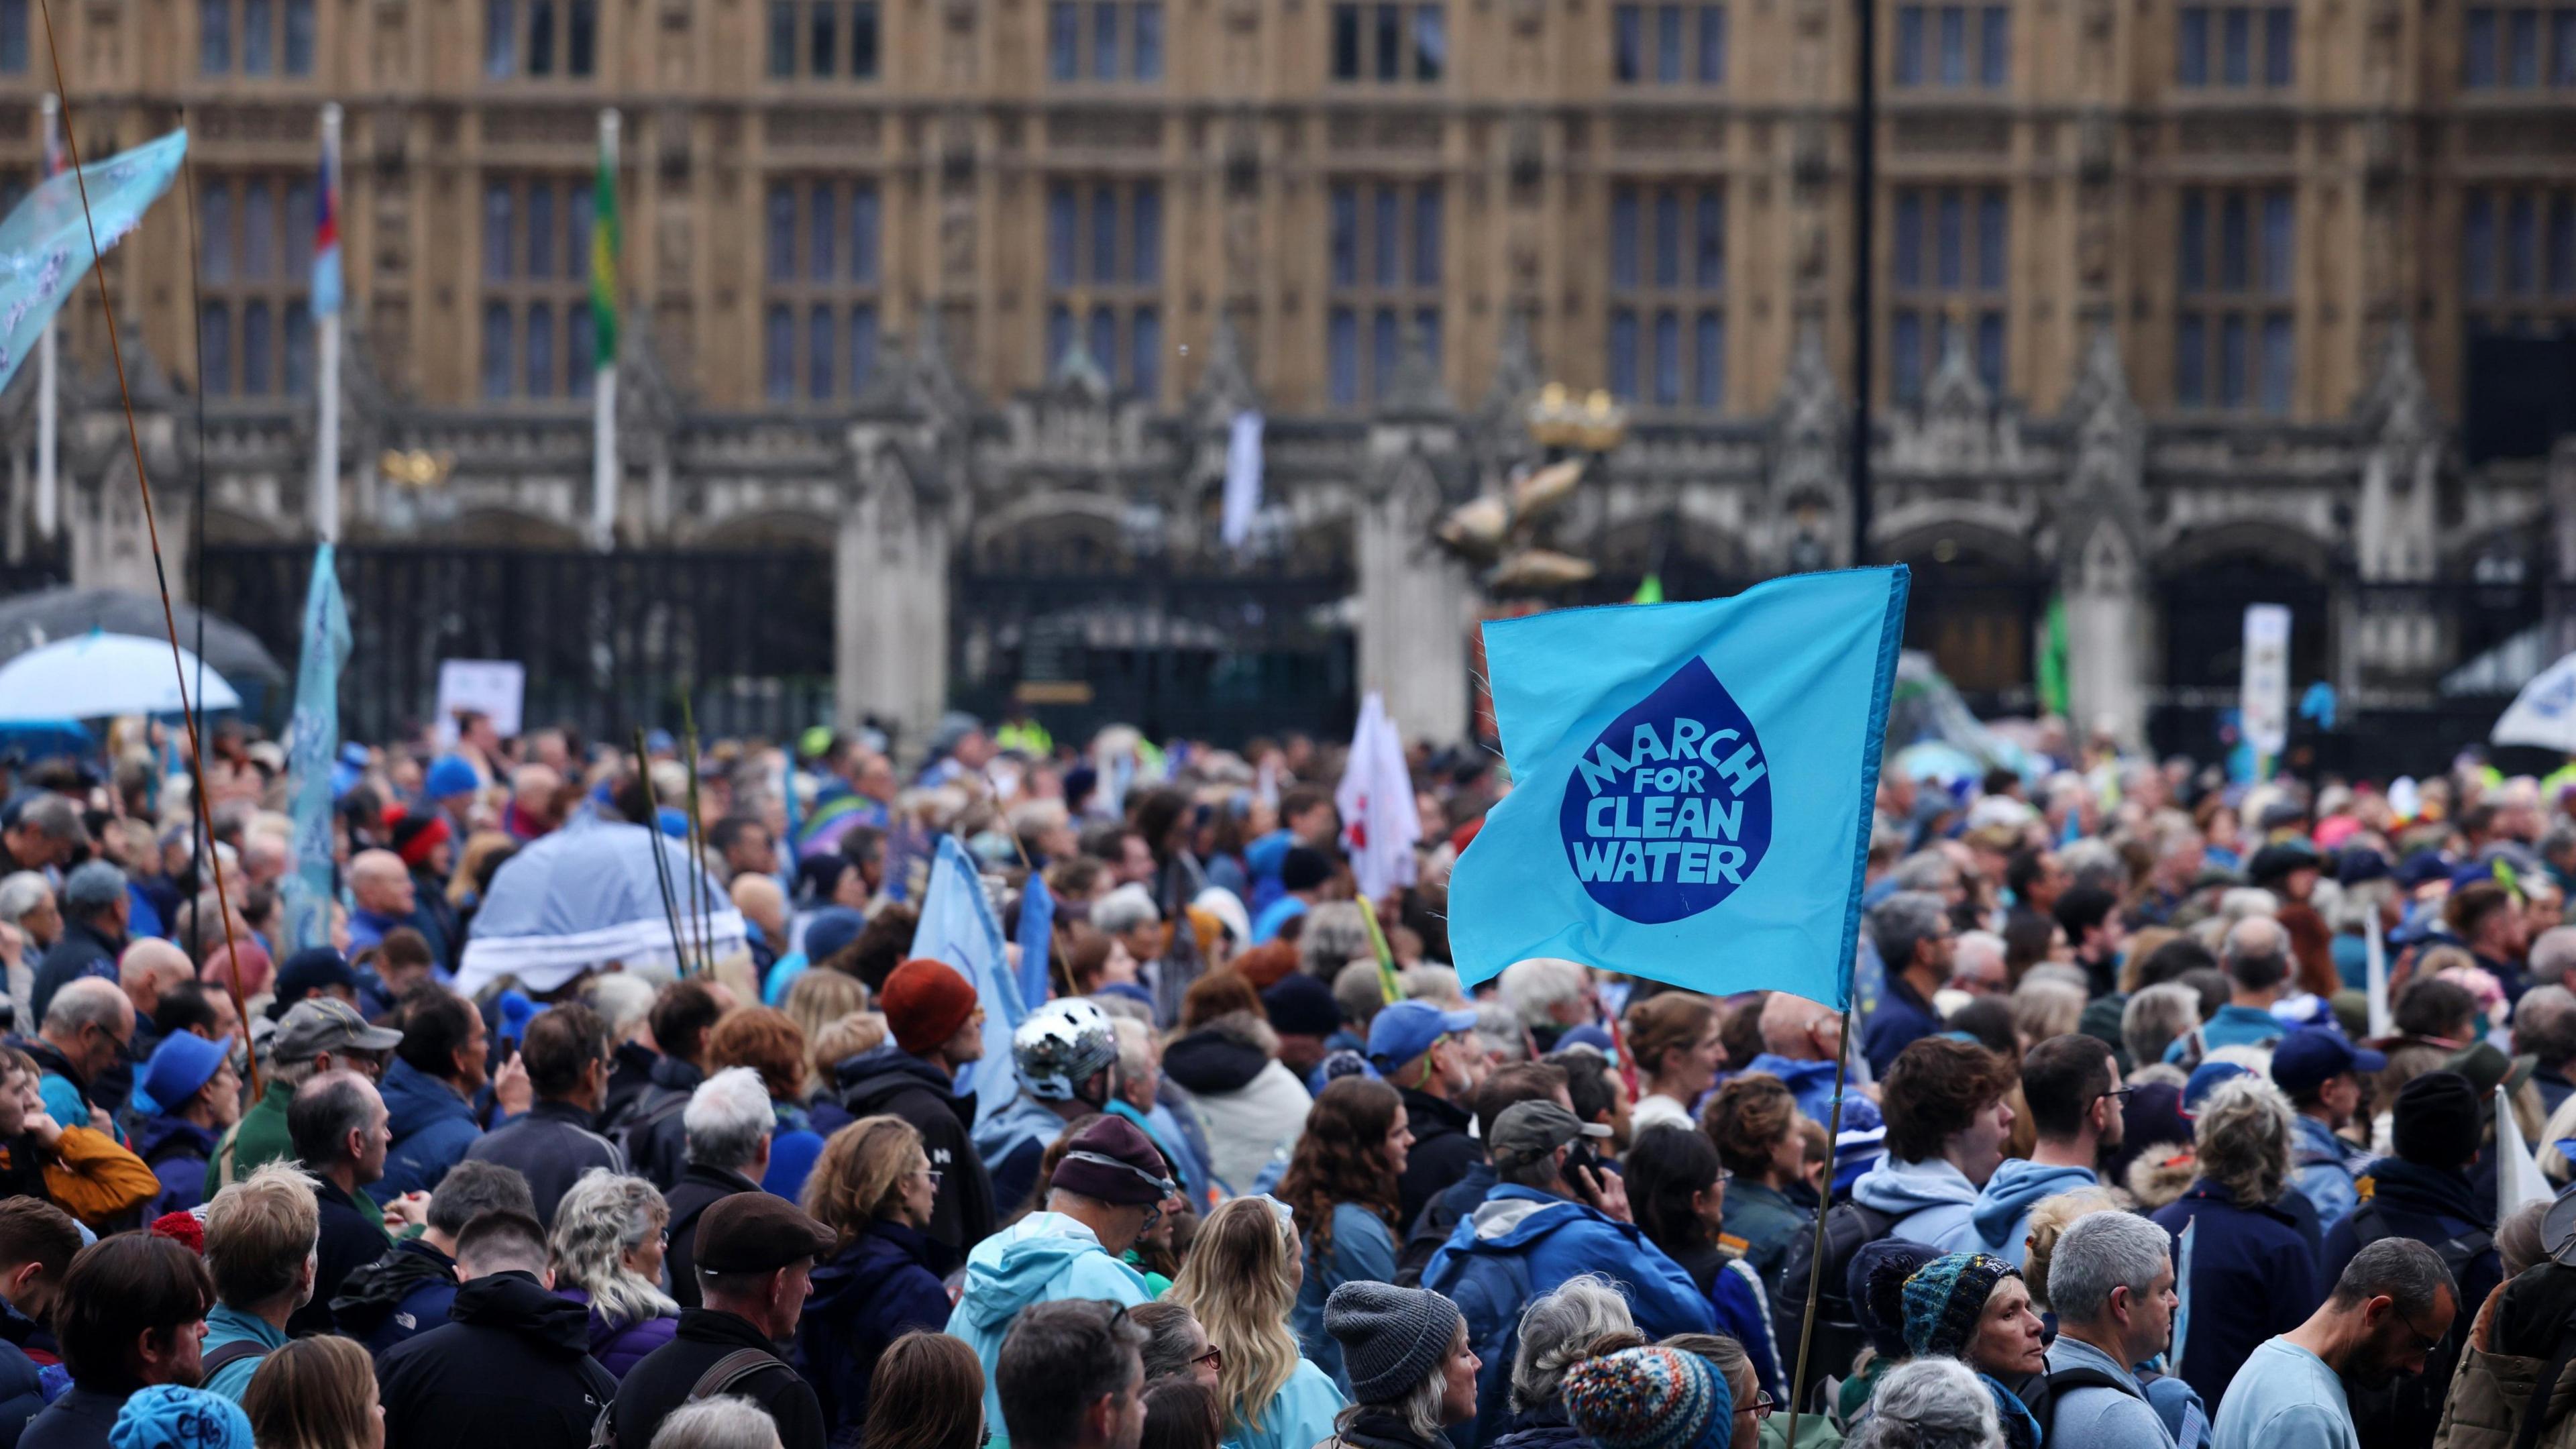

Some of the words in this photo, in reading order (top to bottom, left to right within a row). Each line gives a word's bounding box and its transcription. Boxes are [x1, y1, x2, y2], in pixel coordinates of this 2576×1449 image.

[1577, 717, 1767, 797] MARCH
[1633, 766, 1705, 793] FOR
[1586, 796, 1744, 841] CLEAN
[1572, 841, 1747, 884] WATER
